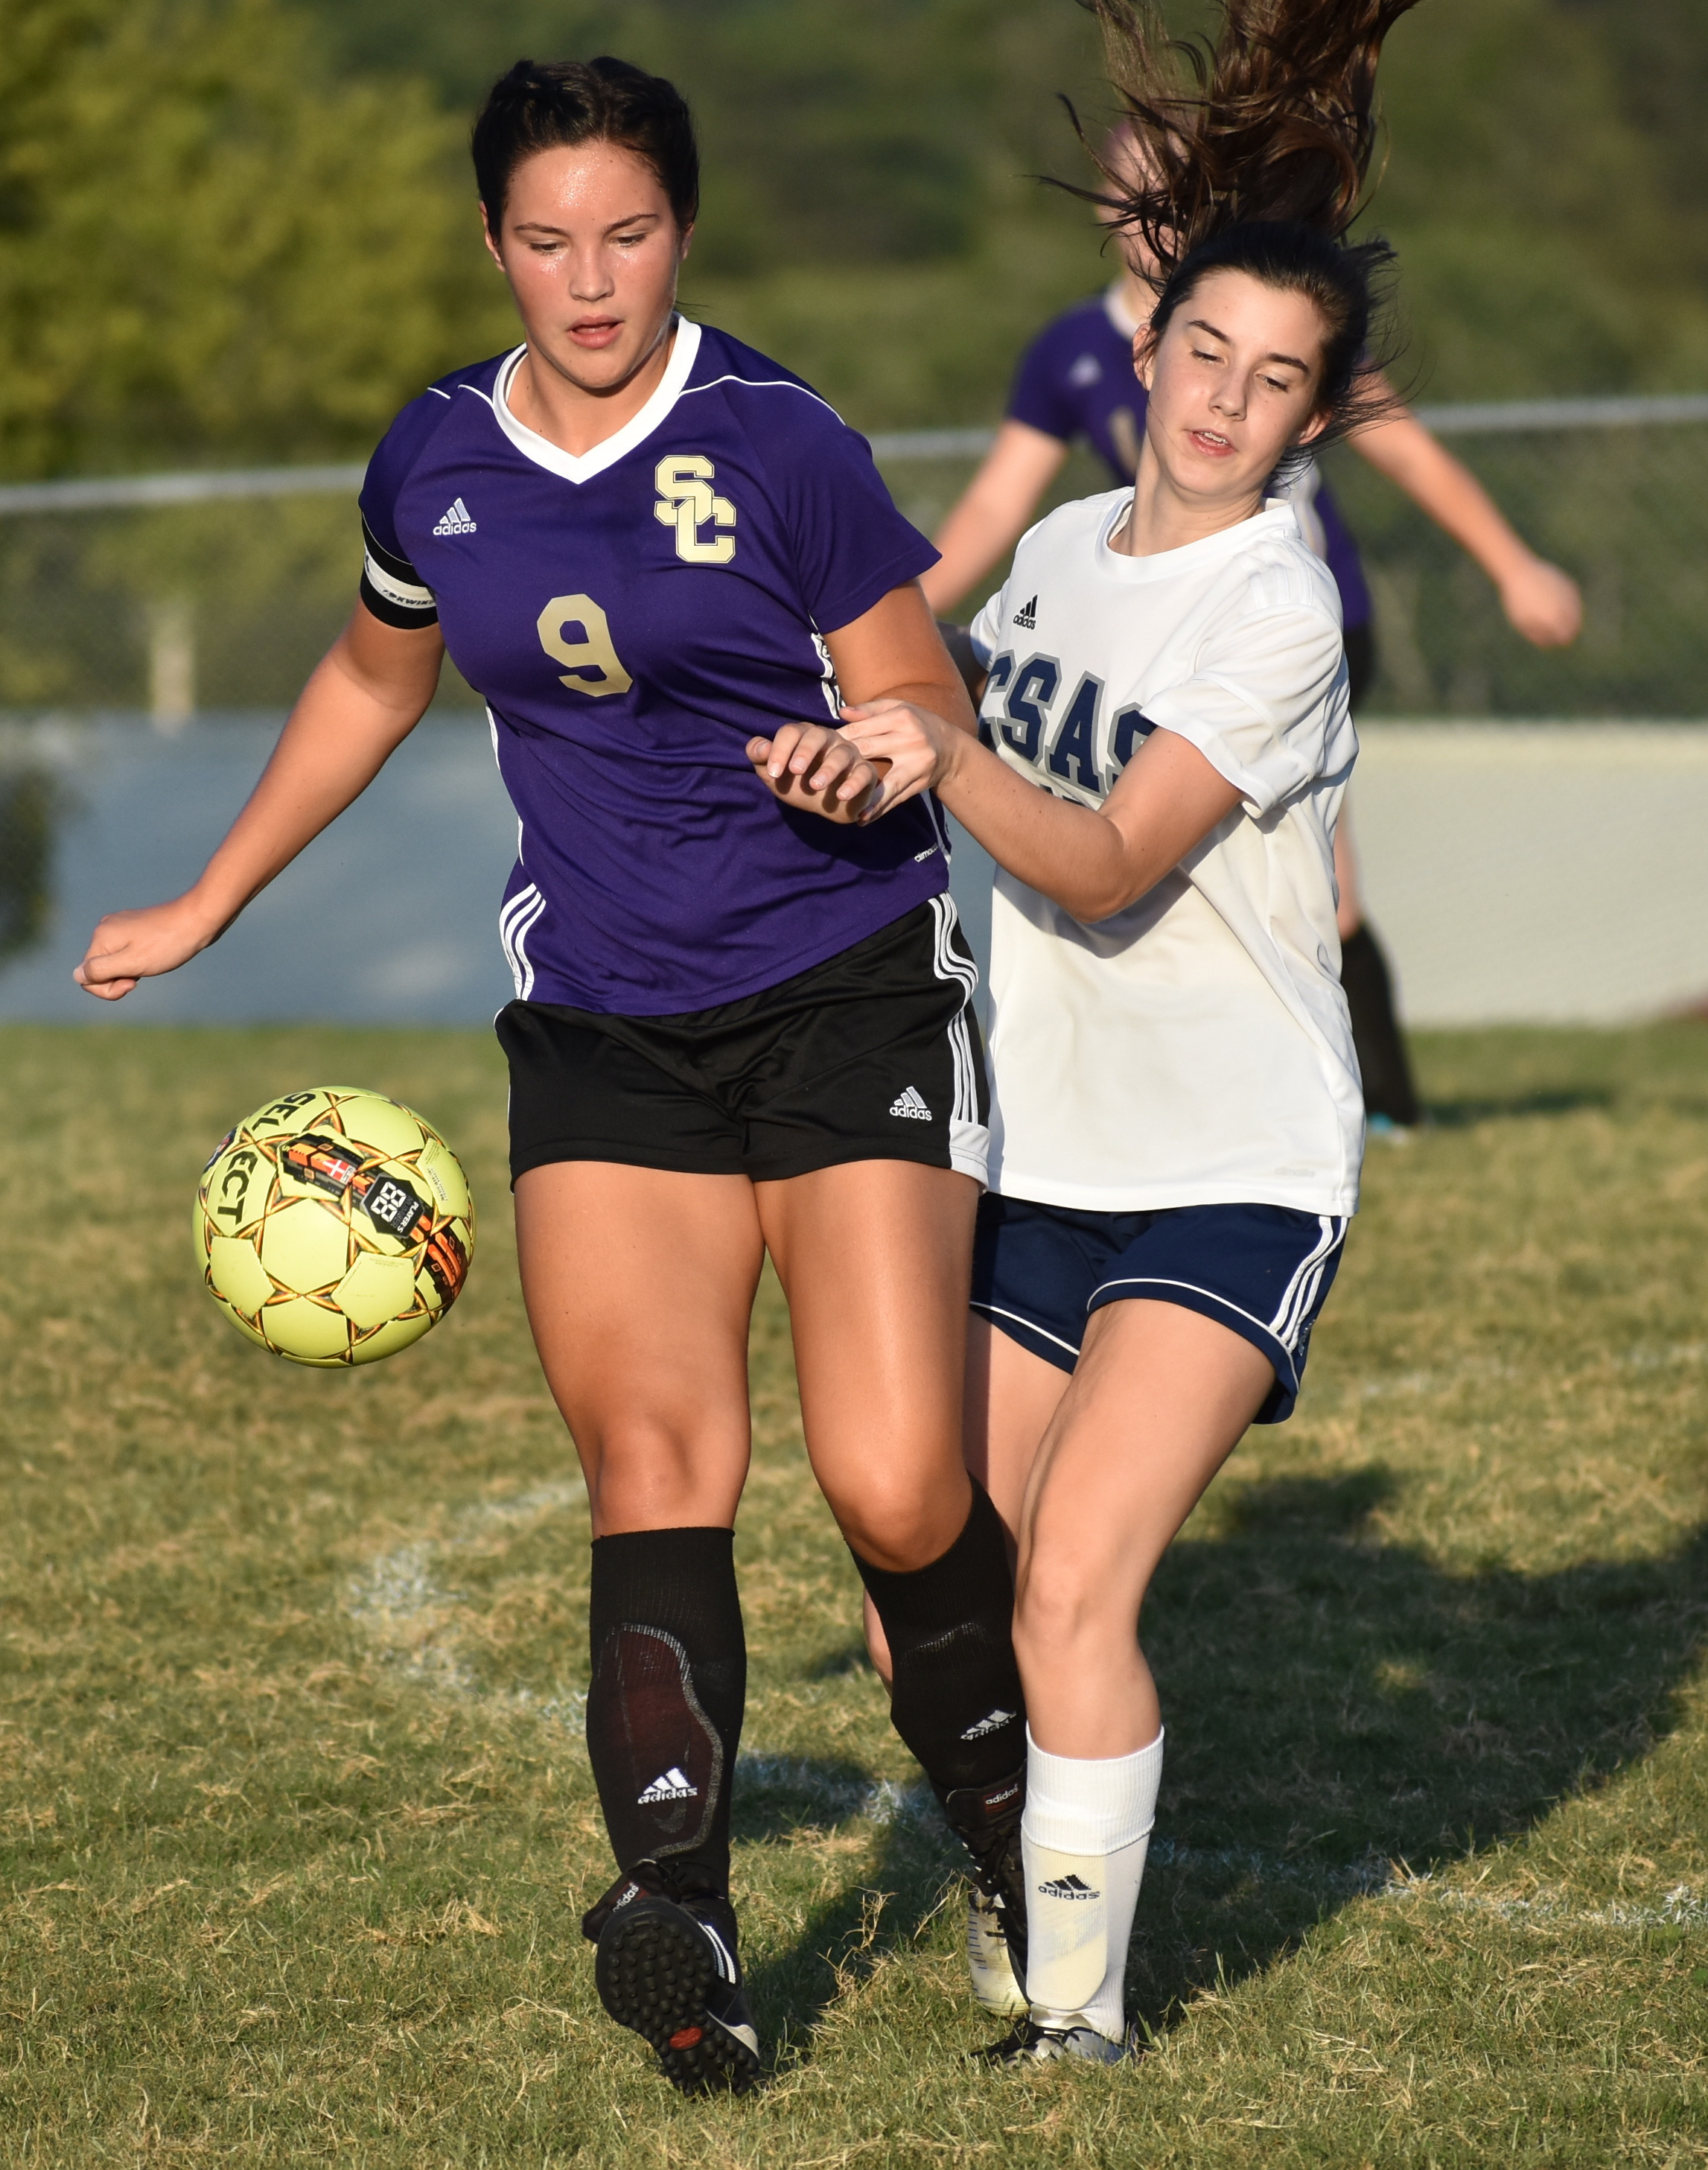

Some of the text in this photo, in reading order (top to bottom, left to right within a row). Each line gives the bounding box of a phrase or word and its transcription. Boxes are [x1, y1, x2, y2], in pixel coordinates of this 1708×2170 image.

[654, 454, 736, 564] SC
[433, 521, 477, 535] adidas
[536, 593, 634, 698] 9
[889, 1105, 932, 1121] adidas
[370, 1181, 407, 1223] 88
[397, 1201, 419, 1233] PLAYER'S
[637, 1787, 698, 1805] adidas
[985, 1784, 1019, 1805] adidas
[1038, 1885, 1100, 1900] adidas
